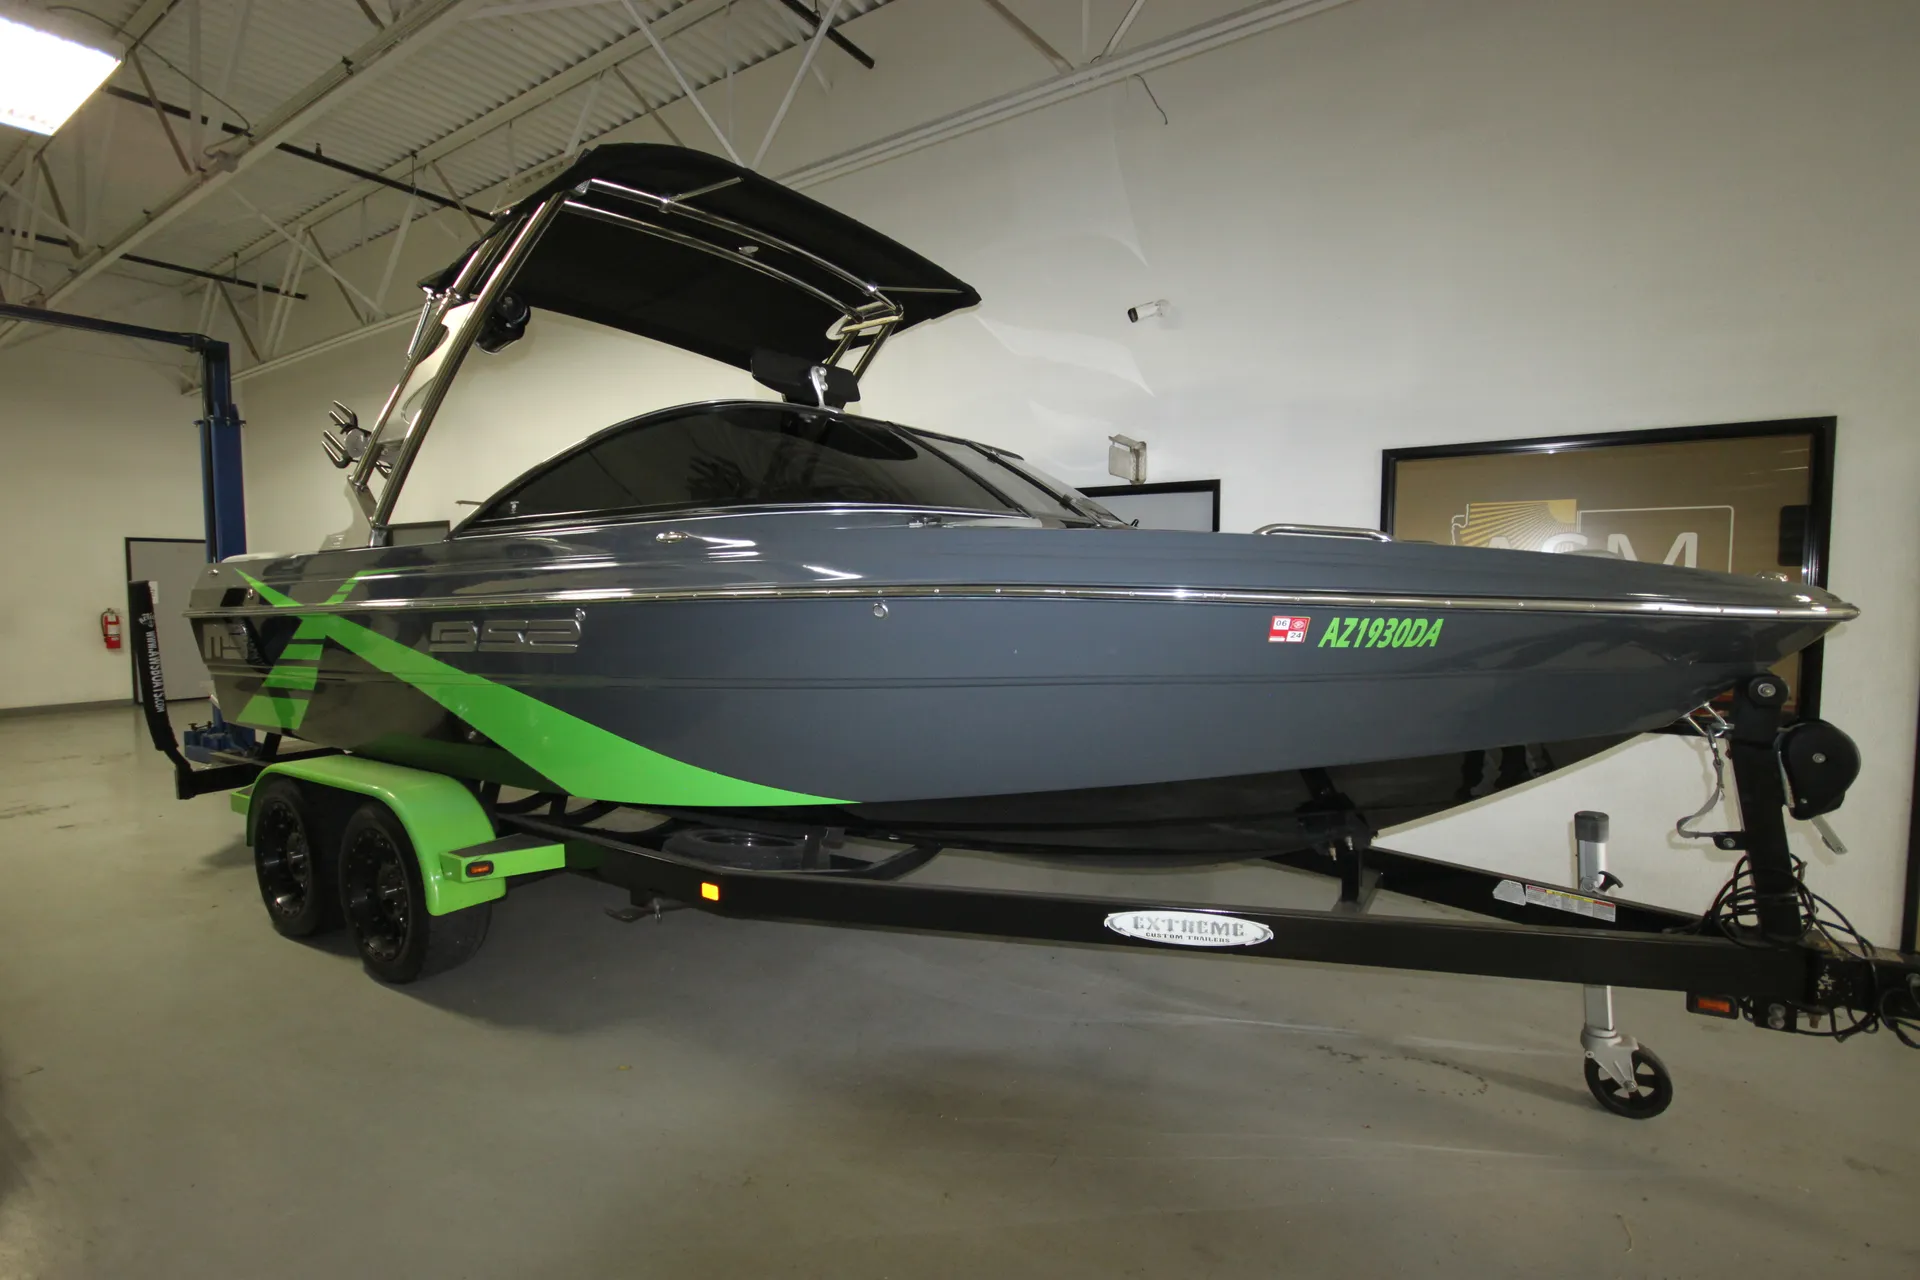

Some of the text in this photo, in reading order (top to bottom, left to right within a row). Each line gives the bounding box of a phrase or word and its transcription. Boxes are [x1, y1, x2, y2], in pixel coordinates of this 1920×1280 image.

[1275, 619, 1288, 627] 06
[1317, 617, 1445, 648] AZ1930DA
[1132, 915, 1246, 937] EXTREME
[1145, 932, 1231, 943] CUSTOM TRAILERS
